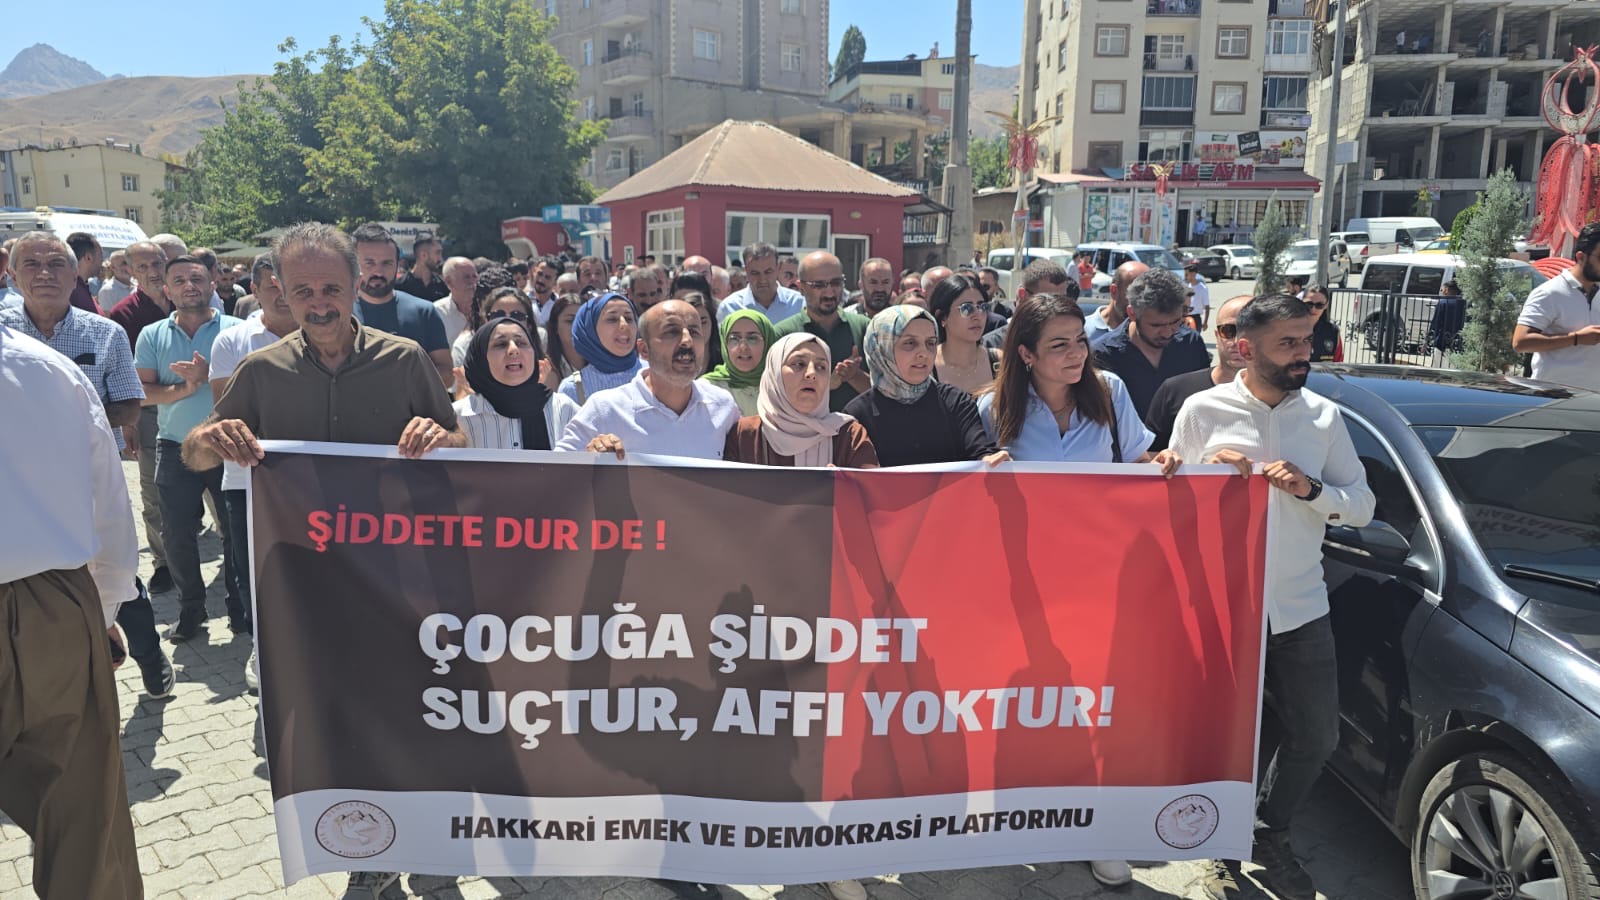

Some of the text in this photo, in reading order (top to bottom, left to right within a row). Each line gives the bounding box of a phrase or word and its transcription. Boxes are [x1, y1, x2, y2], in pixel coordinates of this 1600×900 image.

[307, 504, 666, 552] ŞİDDETE DUR DE !
[418, 602, 928, 675] ÇOCUĞA ŞİDDET
[421, 686, 1115, 750] SUÇTUR, AFFI YOKTUR!
[450, 808, 1094, 848] HAKKARİ EMEK VE DEMOKRASİ PLATFORMU
